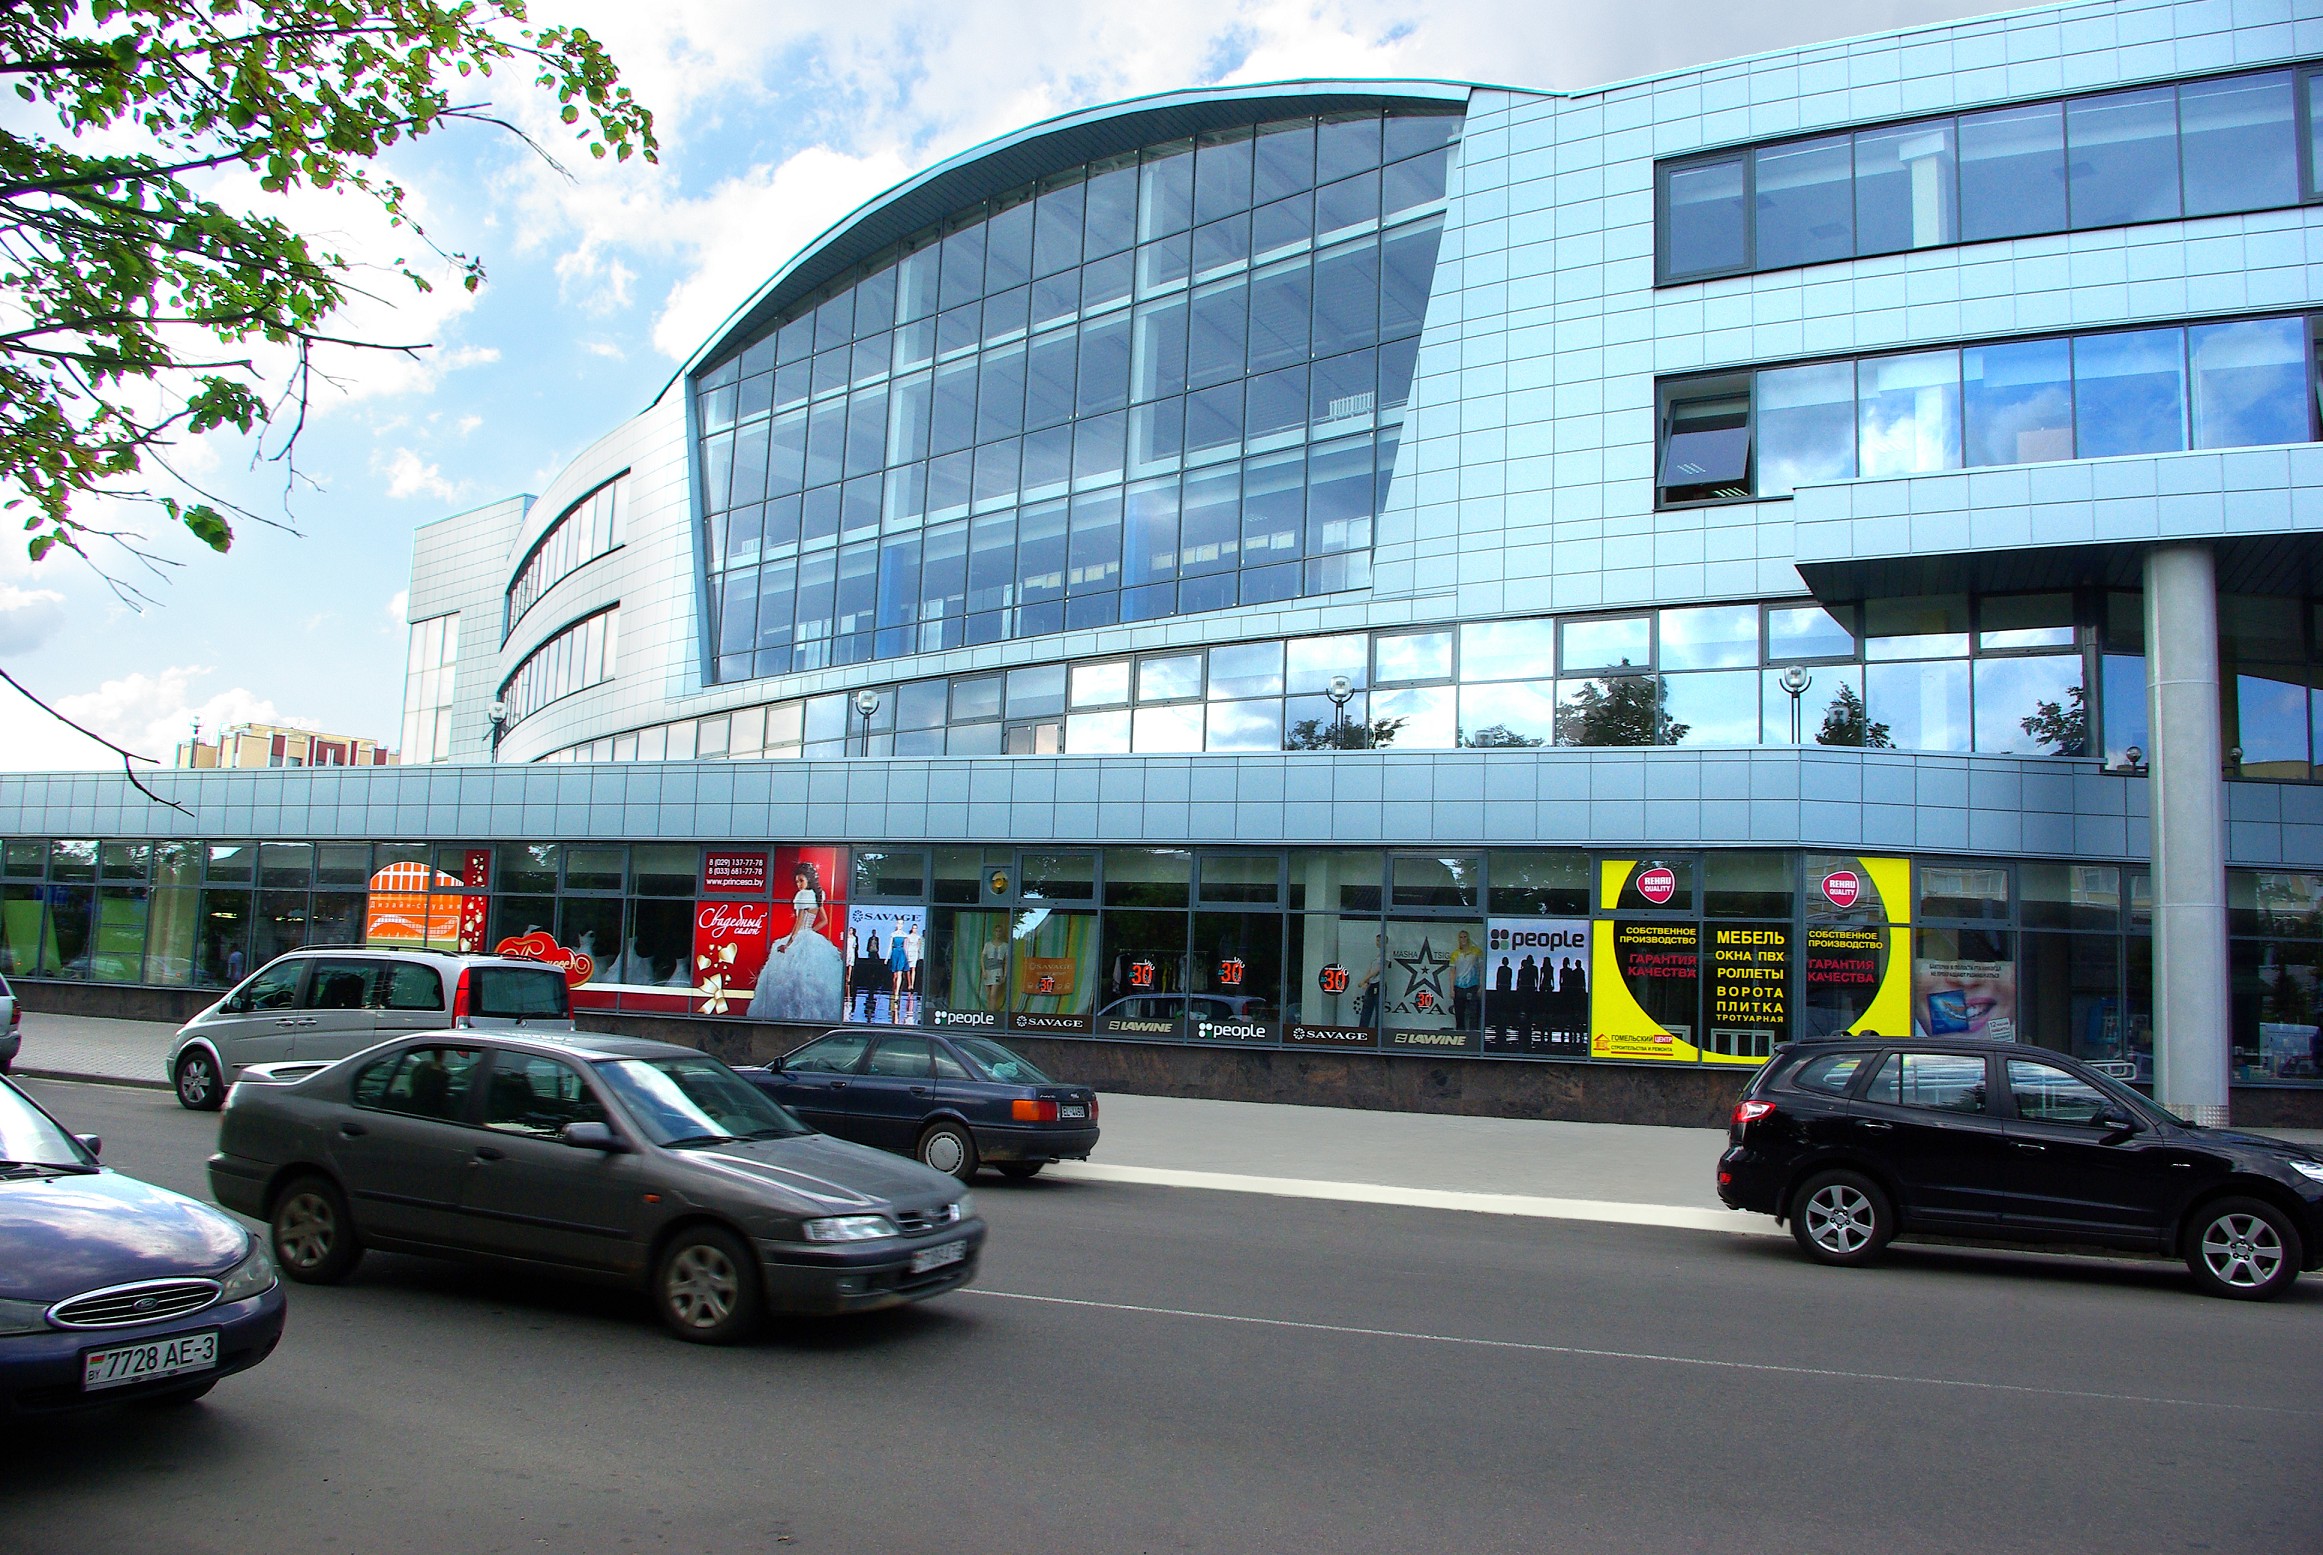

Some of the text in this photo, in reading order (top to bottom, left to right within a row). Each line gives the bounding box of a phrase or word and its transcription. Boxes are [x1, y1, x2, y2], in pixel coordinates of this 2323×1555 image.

[715, 859, 731, 867] (029)
[714, 868, 730, 876] (033)
[731, 868, 763, 876] 681-77-78
[706, 878, 764, 888] www.princesa.by
[1644, 876, 1672, 885] REHAU
[1829, 879, 1856, 889] REHAU
[1829, 888, 1855, 896] QUALITY
[698, 904, 768, 938] Свадебный
[864, 913, 923, 922] SAVAGE
[734, 927, 760, 935] салон
[1625, 927, 1697, 936] СОБСТВЕННОЕ
[1808, 930, 1878, 940] СОБСТВЕННОЕ
[1511, 930, 1585, 952] people
[1619, 936, 1697, 945] ПРОИЗВОДСТВО
[1717, 930, 1785, 945] МЕБЕЛЬ
[1808, 940, 1883, 949] ПРОИЗВОДСТВО
[1629, 953, 1697, 965] ГАРАНТИЯ
[1715, 950, 1784, 962] ОКНА ПВХ
[1808, 959, 1875, 970] ГАРАНТИЯ
[1627, 966, 1697, 978] КАЧЕСТВА
[1717, 968, 1784, 979] РОЛЛЕТЫ
[1807, 971, 1875, 983] КАЧЕСТВА
[1717, 986, 1784, 998] ВОРОТА
[1716, 1001, 1784, 1013] ПЛИТКА
[947, 1012, 995, 1026] people
[1028, 1018, 1083, 1028] SAVAGE
[1716, 1014, 1784, 1023] ТРОТУАРНАЯ
[1120, 1021, 1173, 1033] LAWINE
[1213, 1023, 1266, 1039] people
[1306, 1030, 1368, 1041] SAVAGE
[1408, 1034, 1466, 1046] LAWINE
[1611, 1034, 1653, 1043] ГОМЕЛЬСКИЙ
[107, 1336, 215, 1378] 7728 AE-3
[87, 1367, 102, 1381] BY
